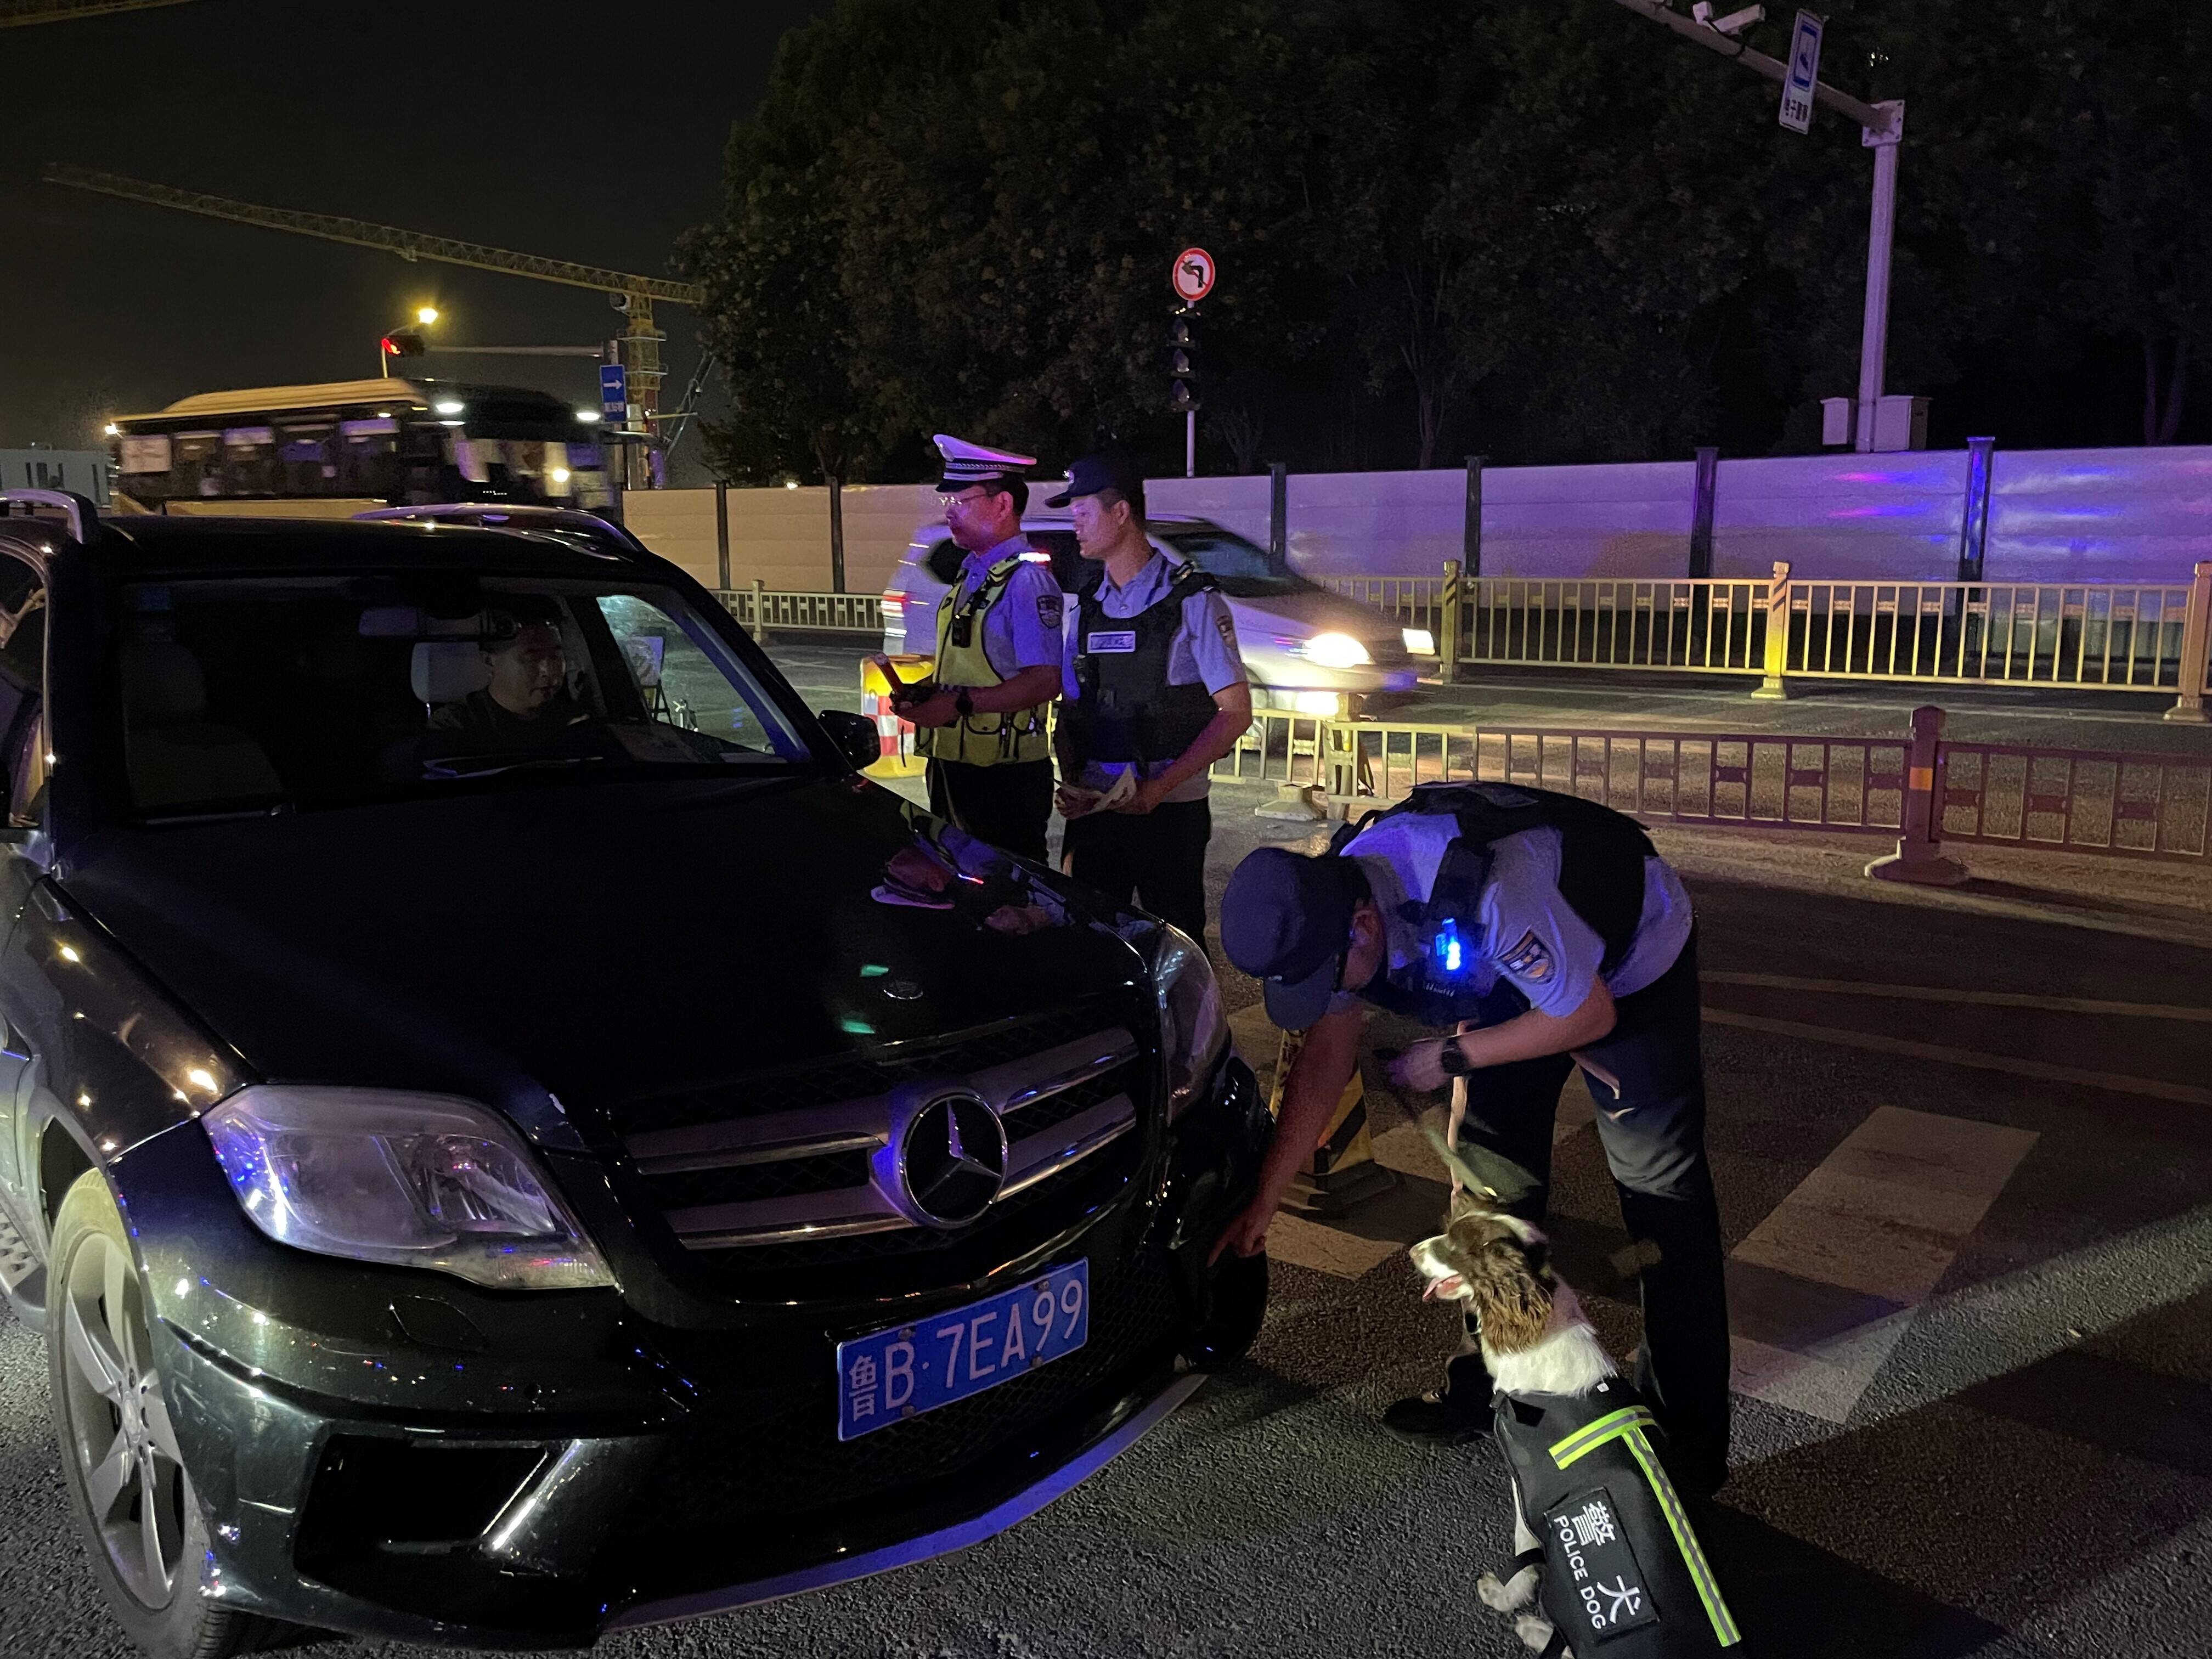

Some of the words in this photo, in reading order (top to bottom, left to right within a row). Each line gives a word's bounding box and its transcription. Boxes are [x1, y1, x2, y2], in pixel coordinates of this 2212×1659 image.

[848, 1278, 1083, 1422] 鲁B·7EA99
[1554, 1514, 1589, 1581] POLICE
[1579, 1587, 1606, 1630] DOG
[1570, 1501, 1641, 1624] 警犬
